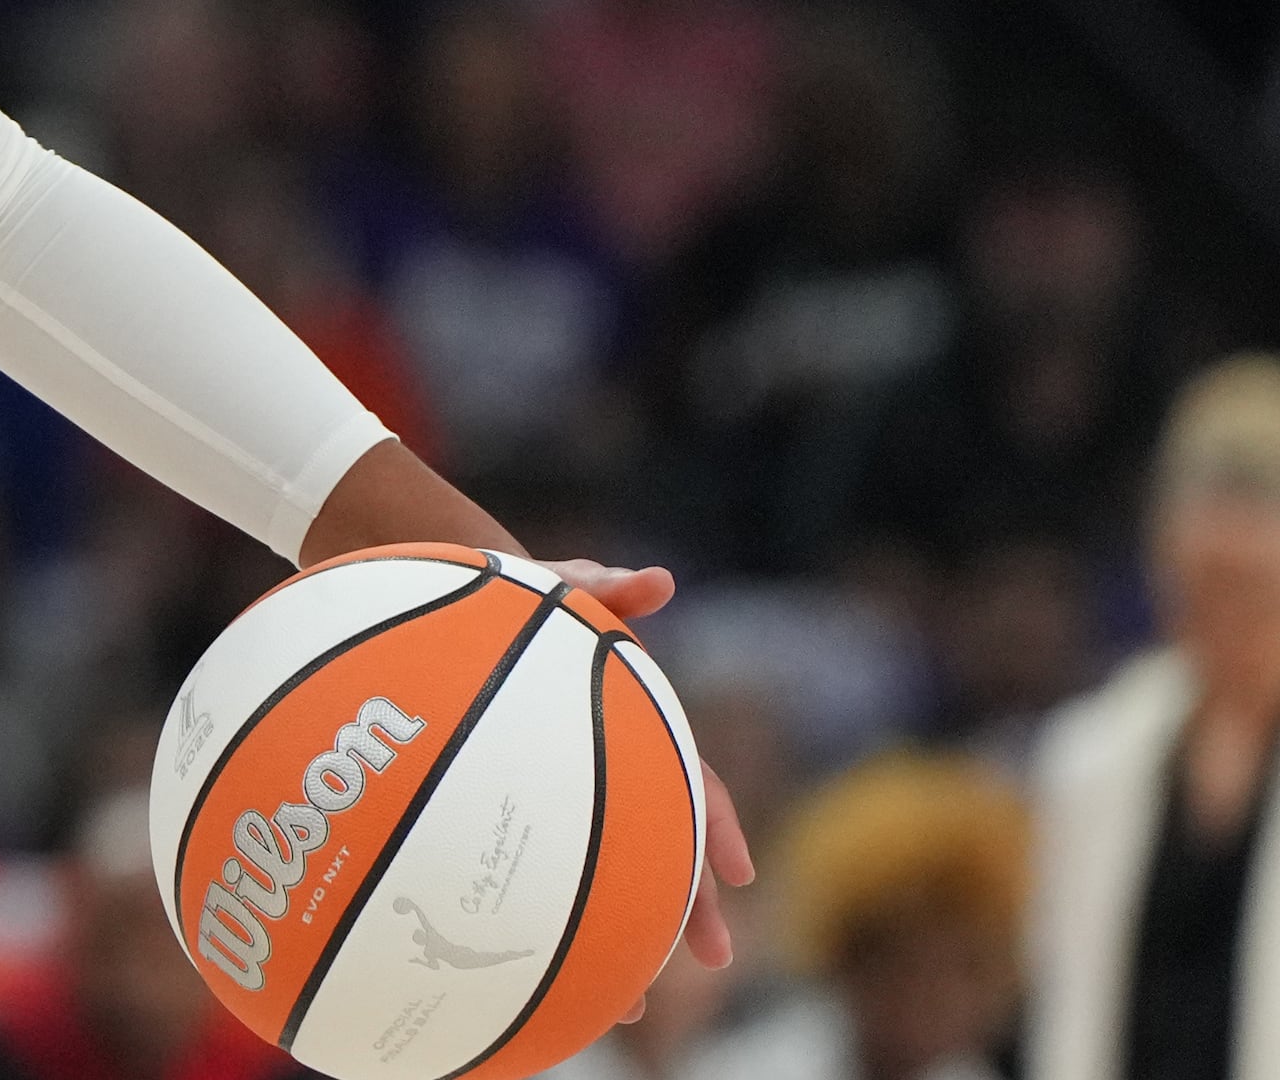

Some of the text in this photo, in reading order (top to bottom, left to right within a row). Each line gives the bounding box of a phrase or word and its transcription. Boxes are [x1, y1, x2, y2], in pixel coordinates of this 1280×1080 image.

[197, 696, 427, 992] Wilson
[302, 844, 351, 925] EVO NXT
